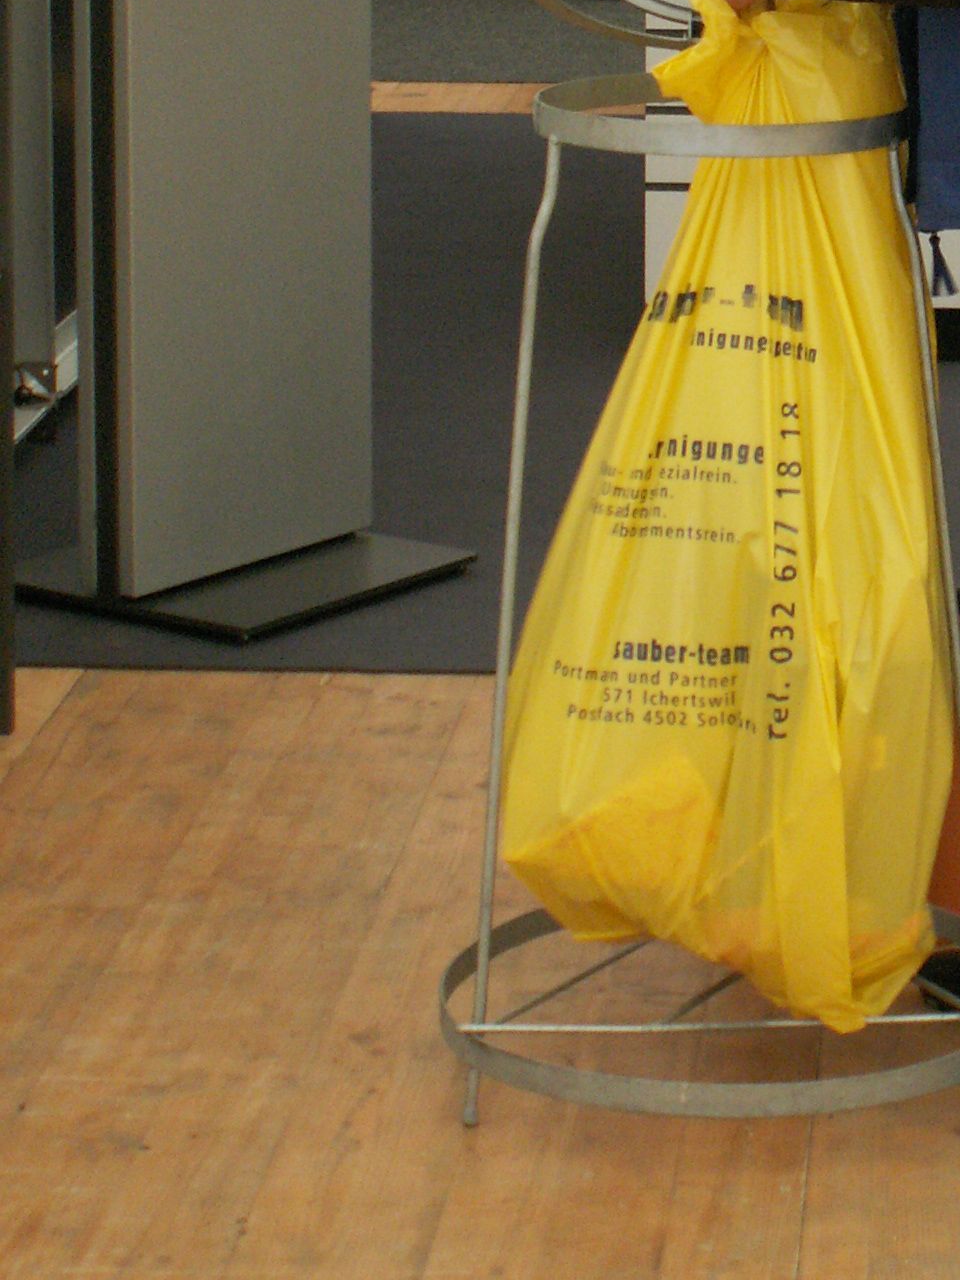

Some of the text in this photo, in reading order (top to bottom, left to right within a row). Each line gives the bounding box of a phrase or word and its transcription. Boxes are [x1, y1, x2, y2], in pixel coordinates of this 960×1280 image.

[775, 461, 802, 499] 18
[773, 521, 799, 582] 677
[768, 602, 796, 665] 032
[612, 638, 750, 667] sauber-team
[628, 670, 661, 686] und
[669, 671, 739, 689] Partner
[643, 710, 688, 726] 4502
